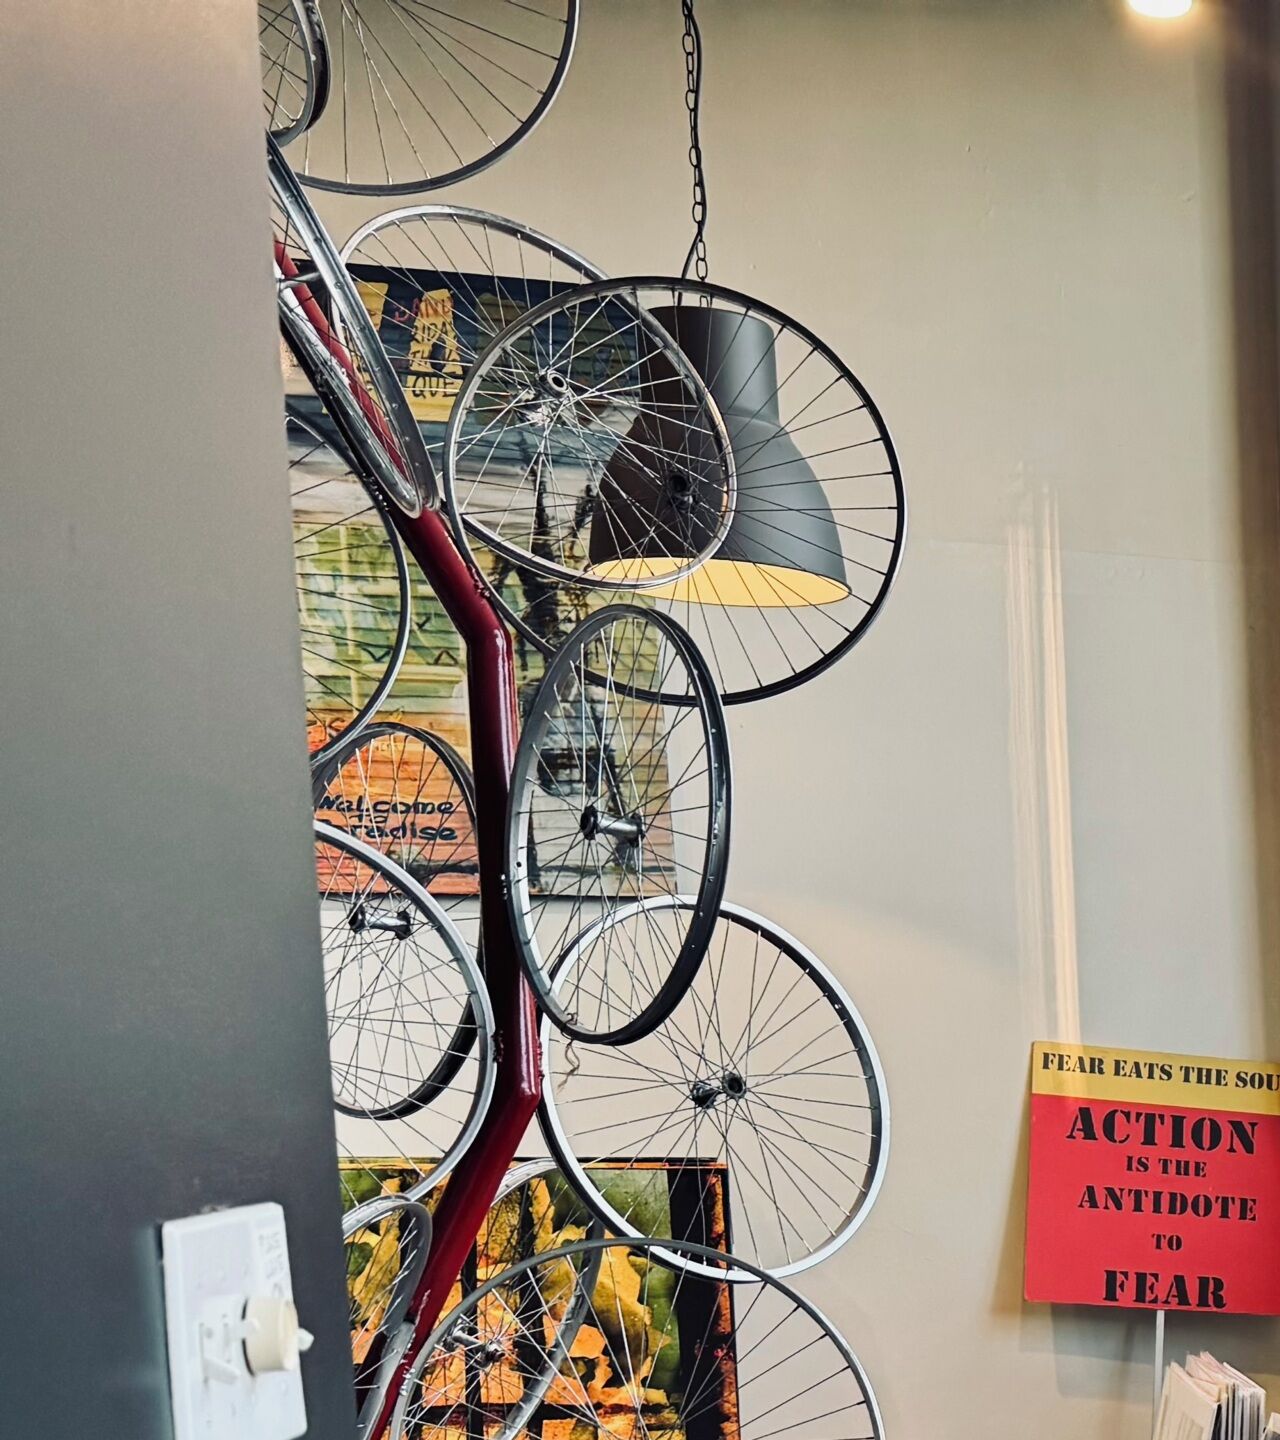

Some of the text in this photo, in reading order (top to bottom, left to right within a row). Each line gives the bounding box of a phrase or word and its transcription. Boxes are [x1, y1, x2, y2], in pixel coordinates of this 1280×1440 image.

[1042, 1052, 1105, 1075] FEAR
[1113, 1059, 1173, 1081] EATS
[1180, 1065, 1228, 1087] THE
[1066, 1107, 1258, 1154] ACTION
[1126, 1155, 1207, 1178] IS THE
[1078, 1185, 1257, 1222] ANTIDOTE
[1152, 1233, 1183, 1251] TO
[1102, 1269, 1227, 1309] FEAR
